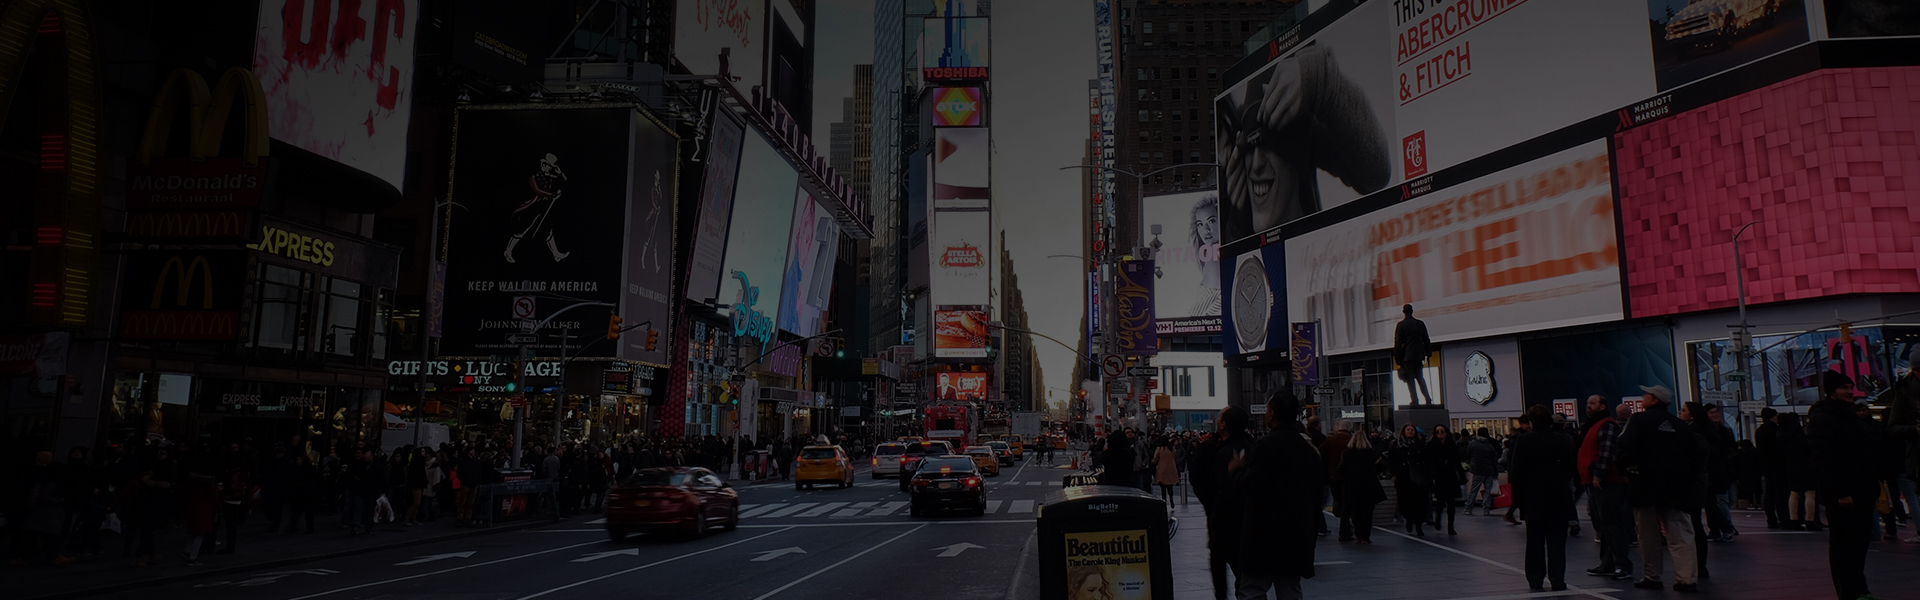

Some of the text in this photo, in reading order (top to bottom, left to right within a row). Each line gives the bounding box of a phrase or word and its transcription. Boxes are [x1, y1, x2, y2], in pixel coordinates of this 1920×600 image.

[1278, 24, 1301, 43] MARRIOTT
[1097, 25, 1113, 64] RUN
[1278, 35, 1300, 53] MARQUIS
[925, 67, 988, 78] TOSHIBA
[1399, 41, 1471, 101] & FITCH
[1100, 69, 1115, 106] THE
[946, 102, 977, 111] TDK
[1634, 95, 1673, 113] MARRIOTT
[1635, 105, 1670, 123] MARQUIS
[756, 86, 800, 150] 1540
[803, 133, 866, 221] BROADWAY
[132, 173, 257, 190] McDonald's
[1410, 175, 1434, 188] MARRIOTT
[151, 193, 234, 203] Restaurant
[1411, 184, 1432, 196] MARQUIS
[246, 225, 335, 267] XPRESS
[1156, 246, 1196, 264] RITA
[468, 281, 598, 292] KEEP WALING AMERICA
[629, 283, 668, 305] KEEP WALKING AMERICA
[478, 319, 525, 331] JOHNNI
[1174, 319, 1201, 327] America's
[1202, 318, 1216, 326] Next
[388, 360, 449, 376] GIFTS
[459, 376, 492, 384] I NY
[222, 393, 261, 405] EXPRESS
[279, 396, 313, 408] EXPRESS
[1088, 503, 1119, 511] BigBelly
[1067, 535, 1147, 557] Beautiful
[1068, 556, 1147, 567] The Carole King Musical
